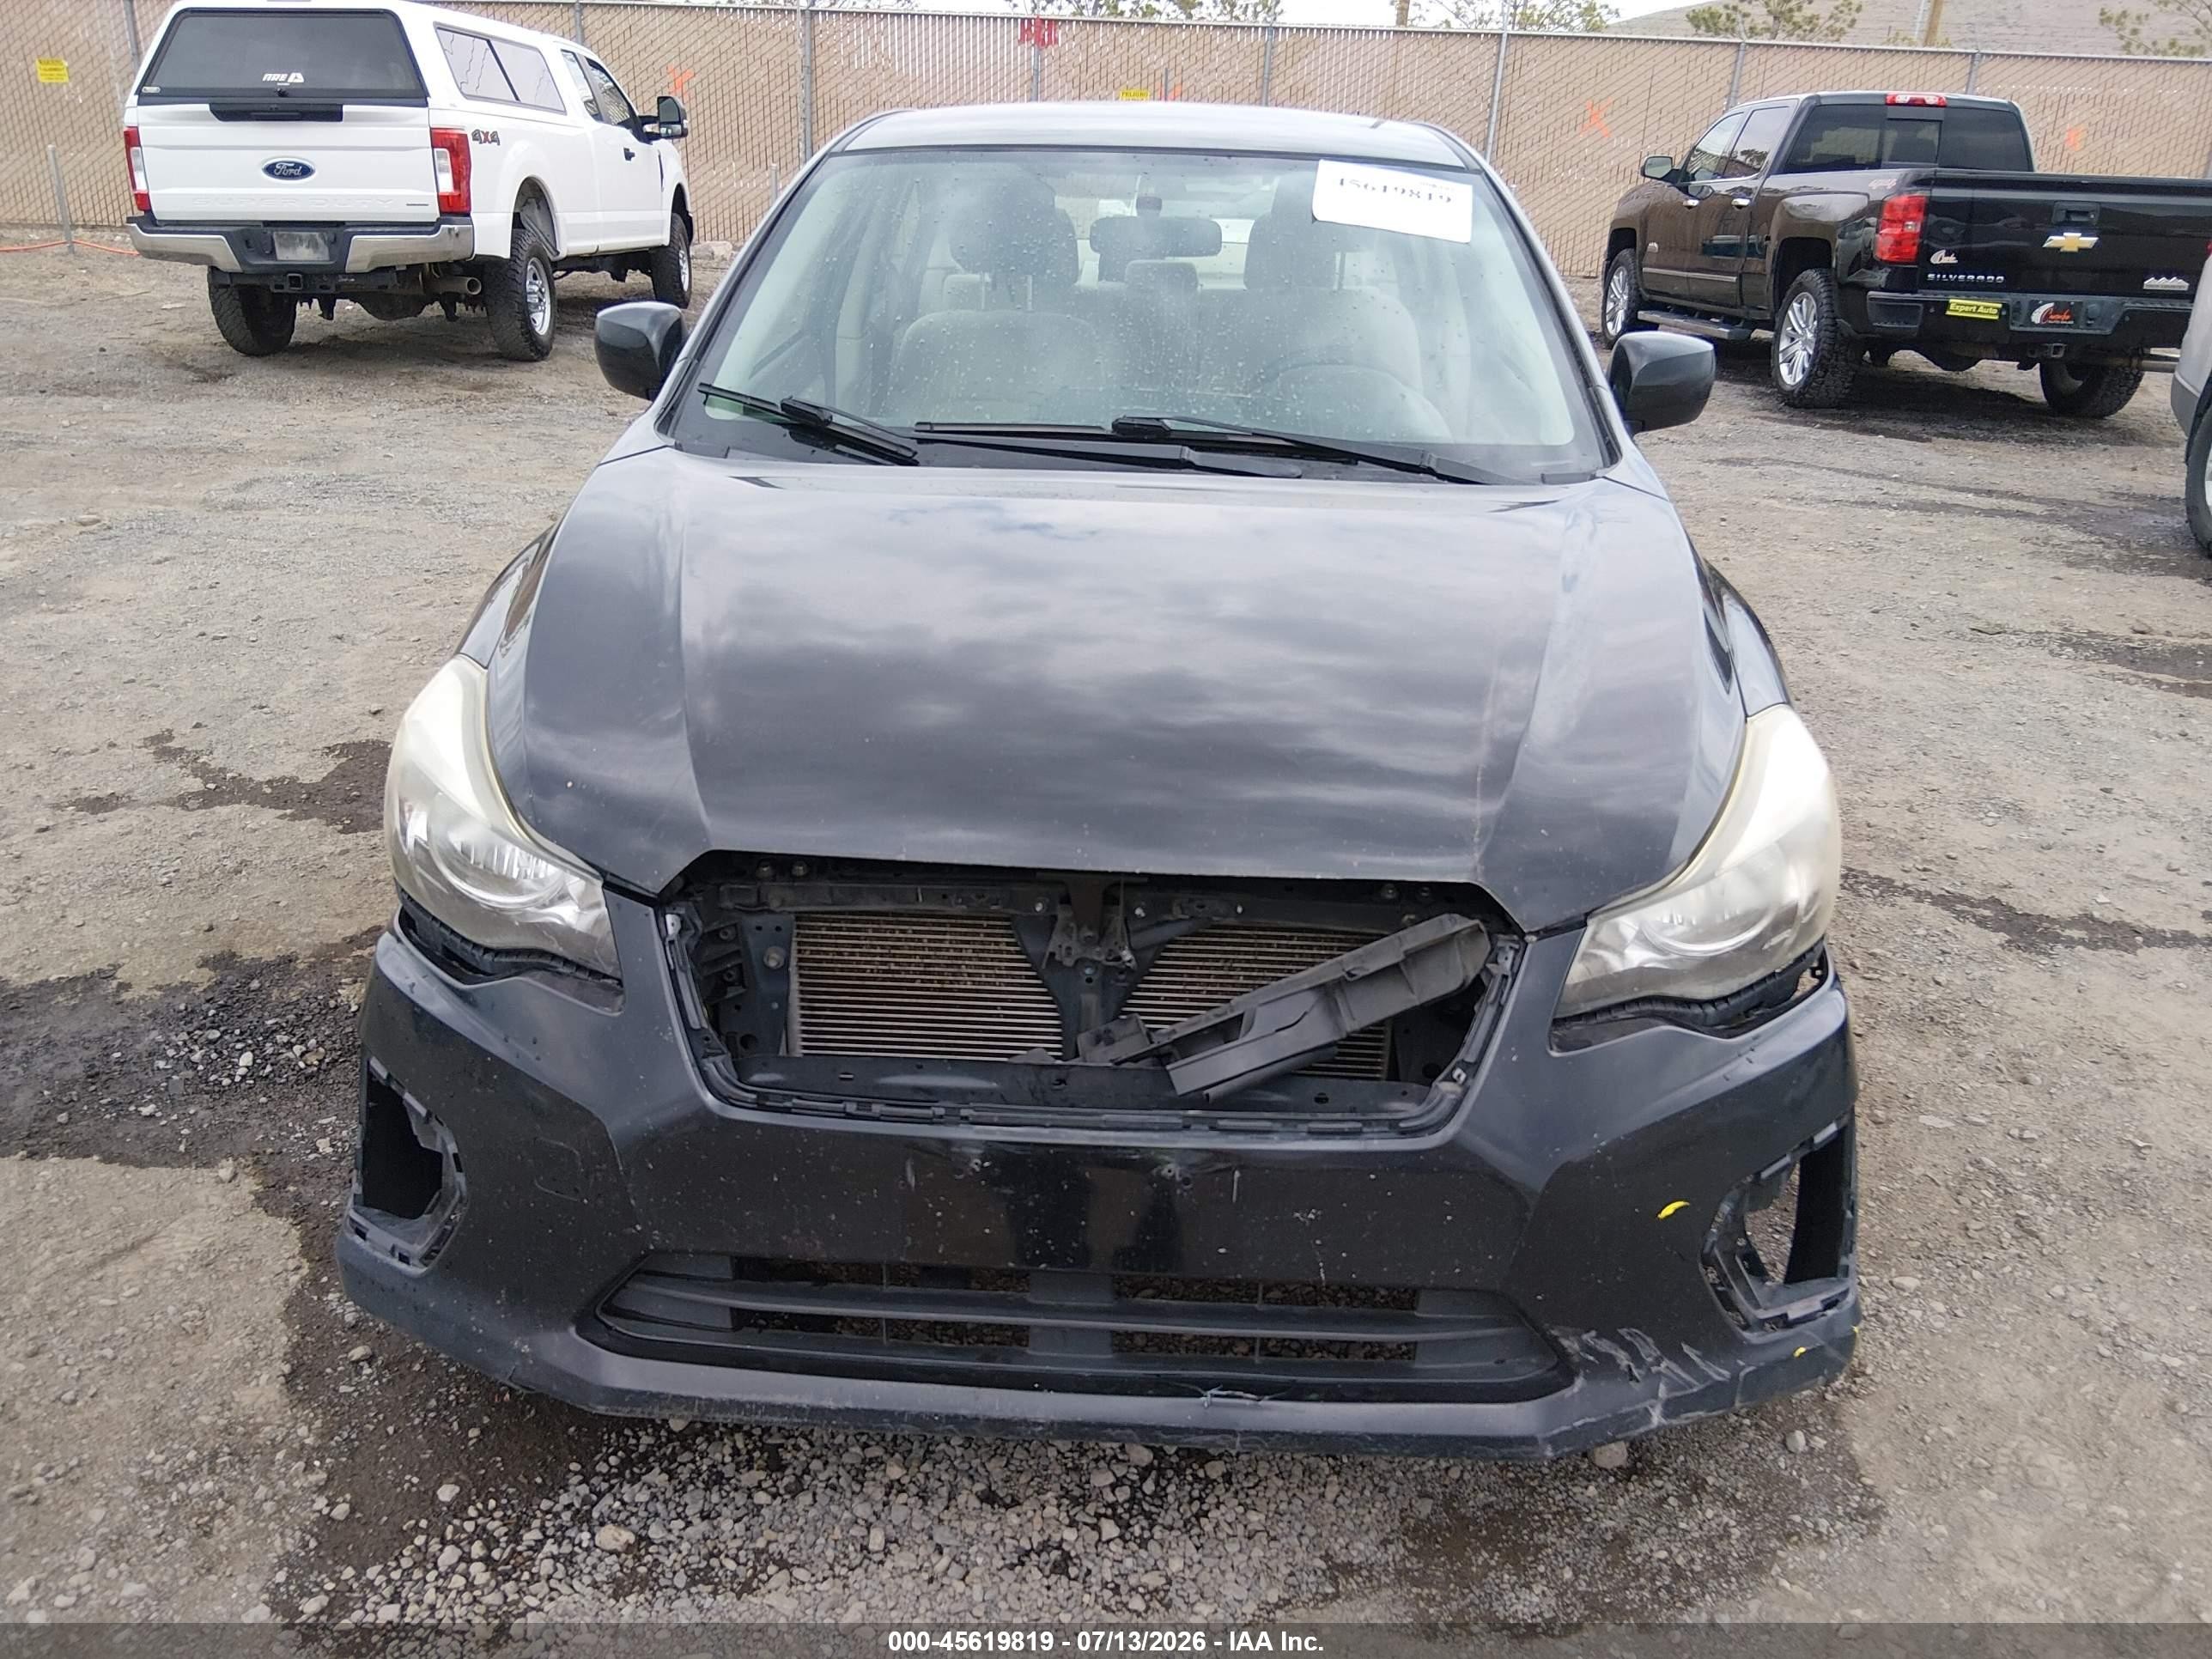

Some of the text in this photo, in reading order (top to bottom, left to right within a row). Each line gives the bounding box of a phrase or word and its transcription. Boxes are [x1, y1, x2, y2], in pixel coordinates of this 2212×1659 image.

[274, 162, 302, 176] Ford
[191, 197, 394, 208] SUPER DUTY
[1927, 273, 2005, 283] SILVERADO
[1949, 302, 1999, 315] Expert Auto
